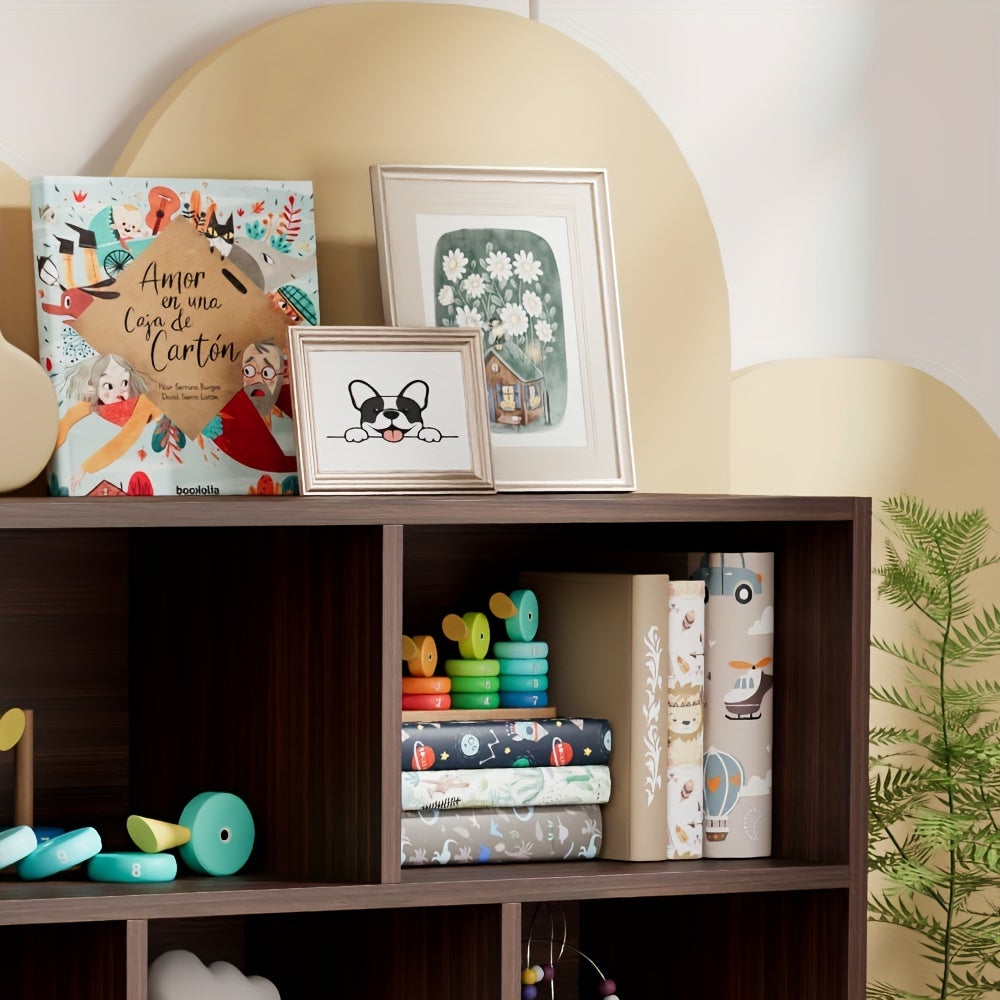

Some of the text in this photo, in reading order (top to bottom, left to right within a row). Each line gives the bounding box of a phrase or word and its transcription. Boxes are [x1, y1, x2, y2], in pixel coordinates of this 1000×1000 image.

[139, 260, 206, 296] Amor
[161, 295, 223, 311] en una
[124, 306, 193, 342] Caja de
[151, 329, 241, 373] Cartón
[533, 695, 539, 706] 7
[132, 863, 142, 878] 8
